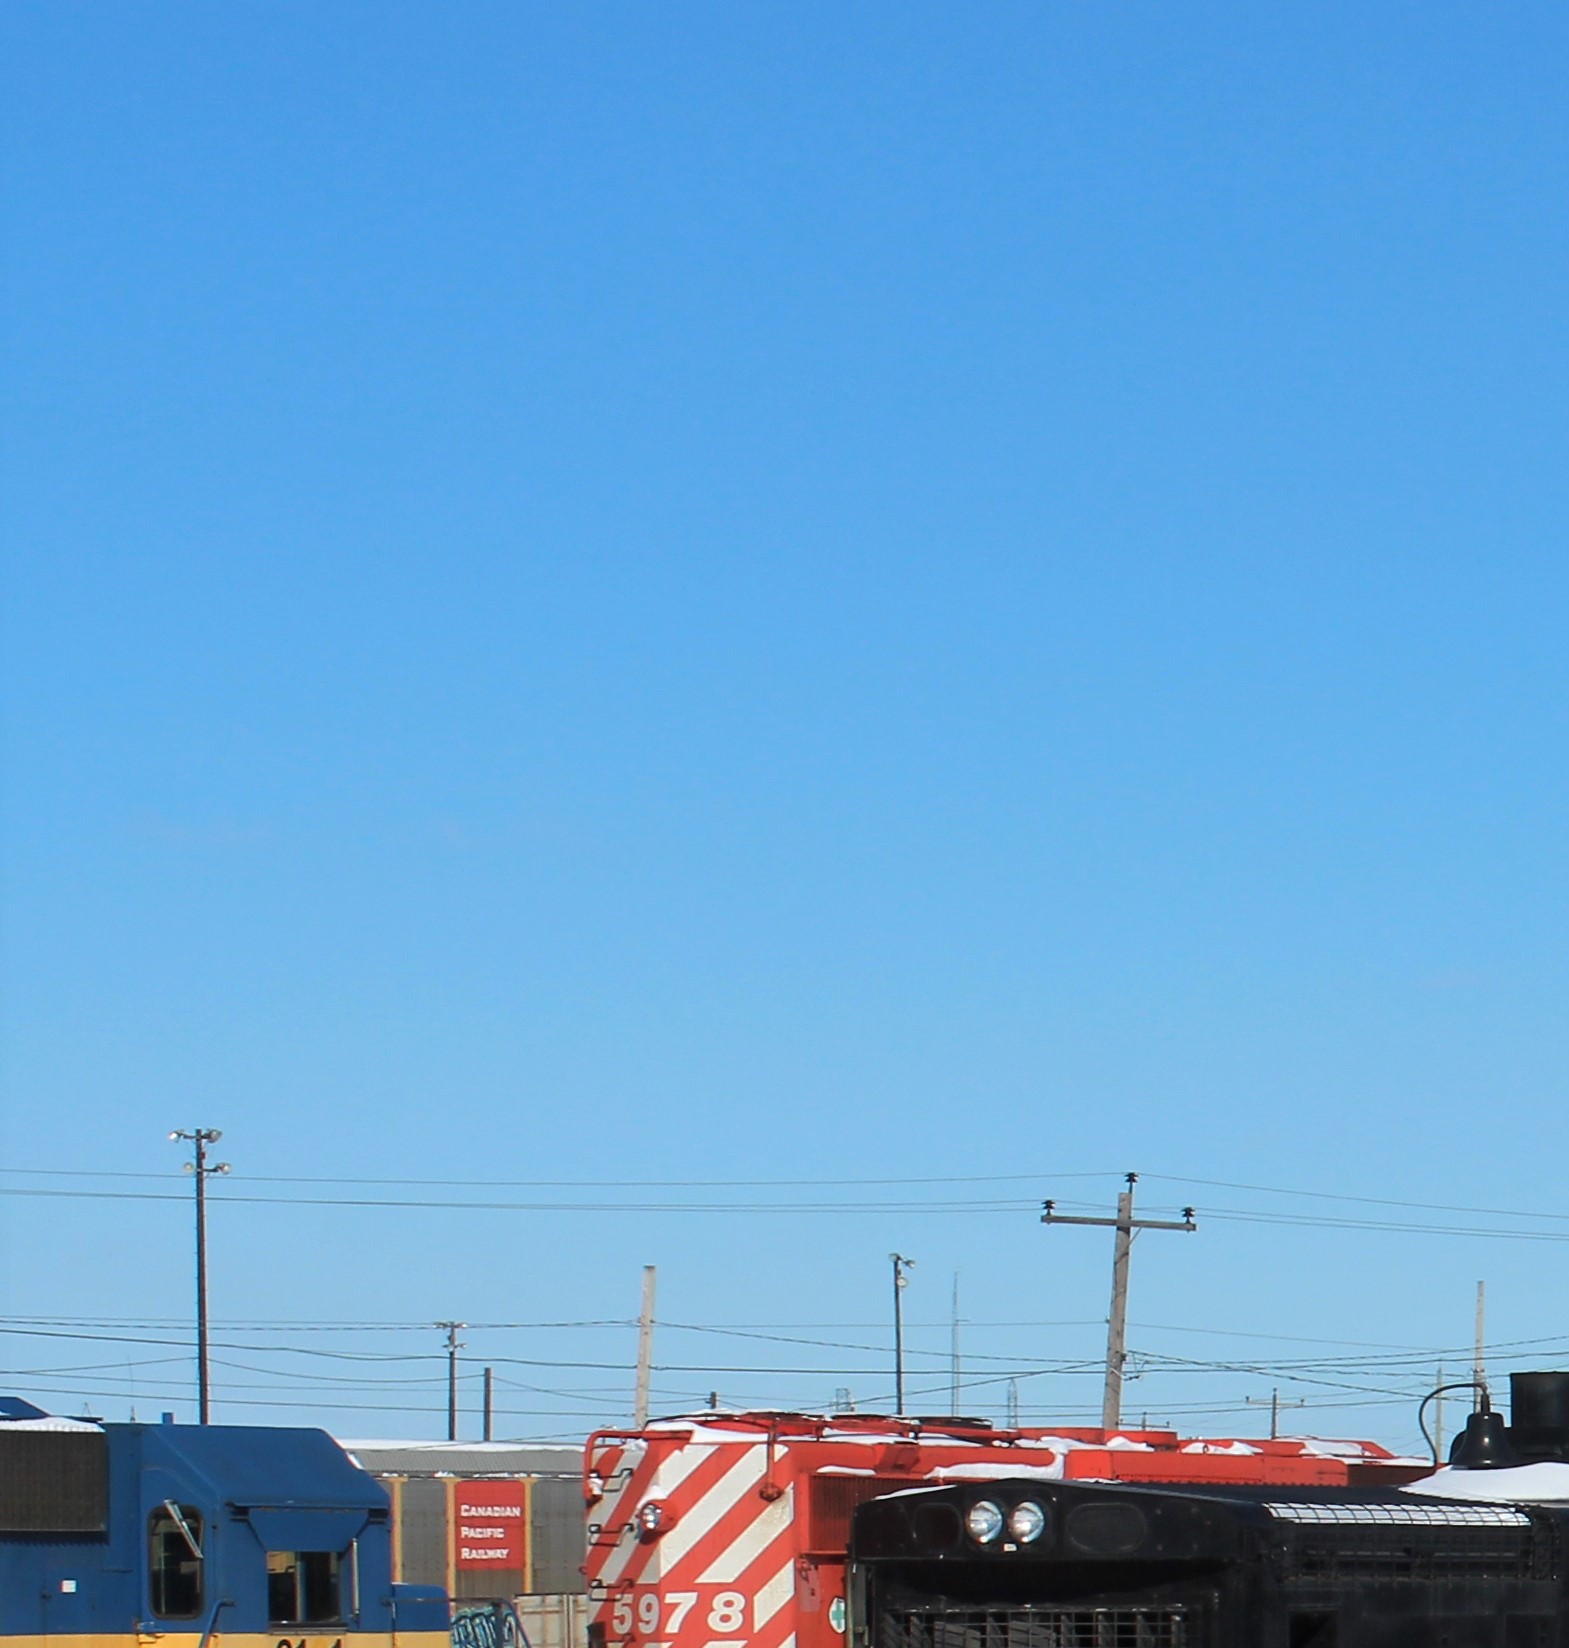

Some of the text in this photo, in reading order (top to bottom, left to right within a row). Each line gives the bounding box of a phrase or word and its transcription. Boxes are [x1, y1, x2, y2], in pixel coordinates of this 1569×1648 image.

[461, 1504, 521, 1517] CANADIAN
[461, 1526, 504, 1538] PACIFIC
[461, 1548, 509, 1559] RAILWAY
[612, 1591, 746, 1634] 5978
